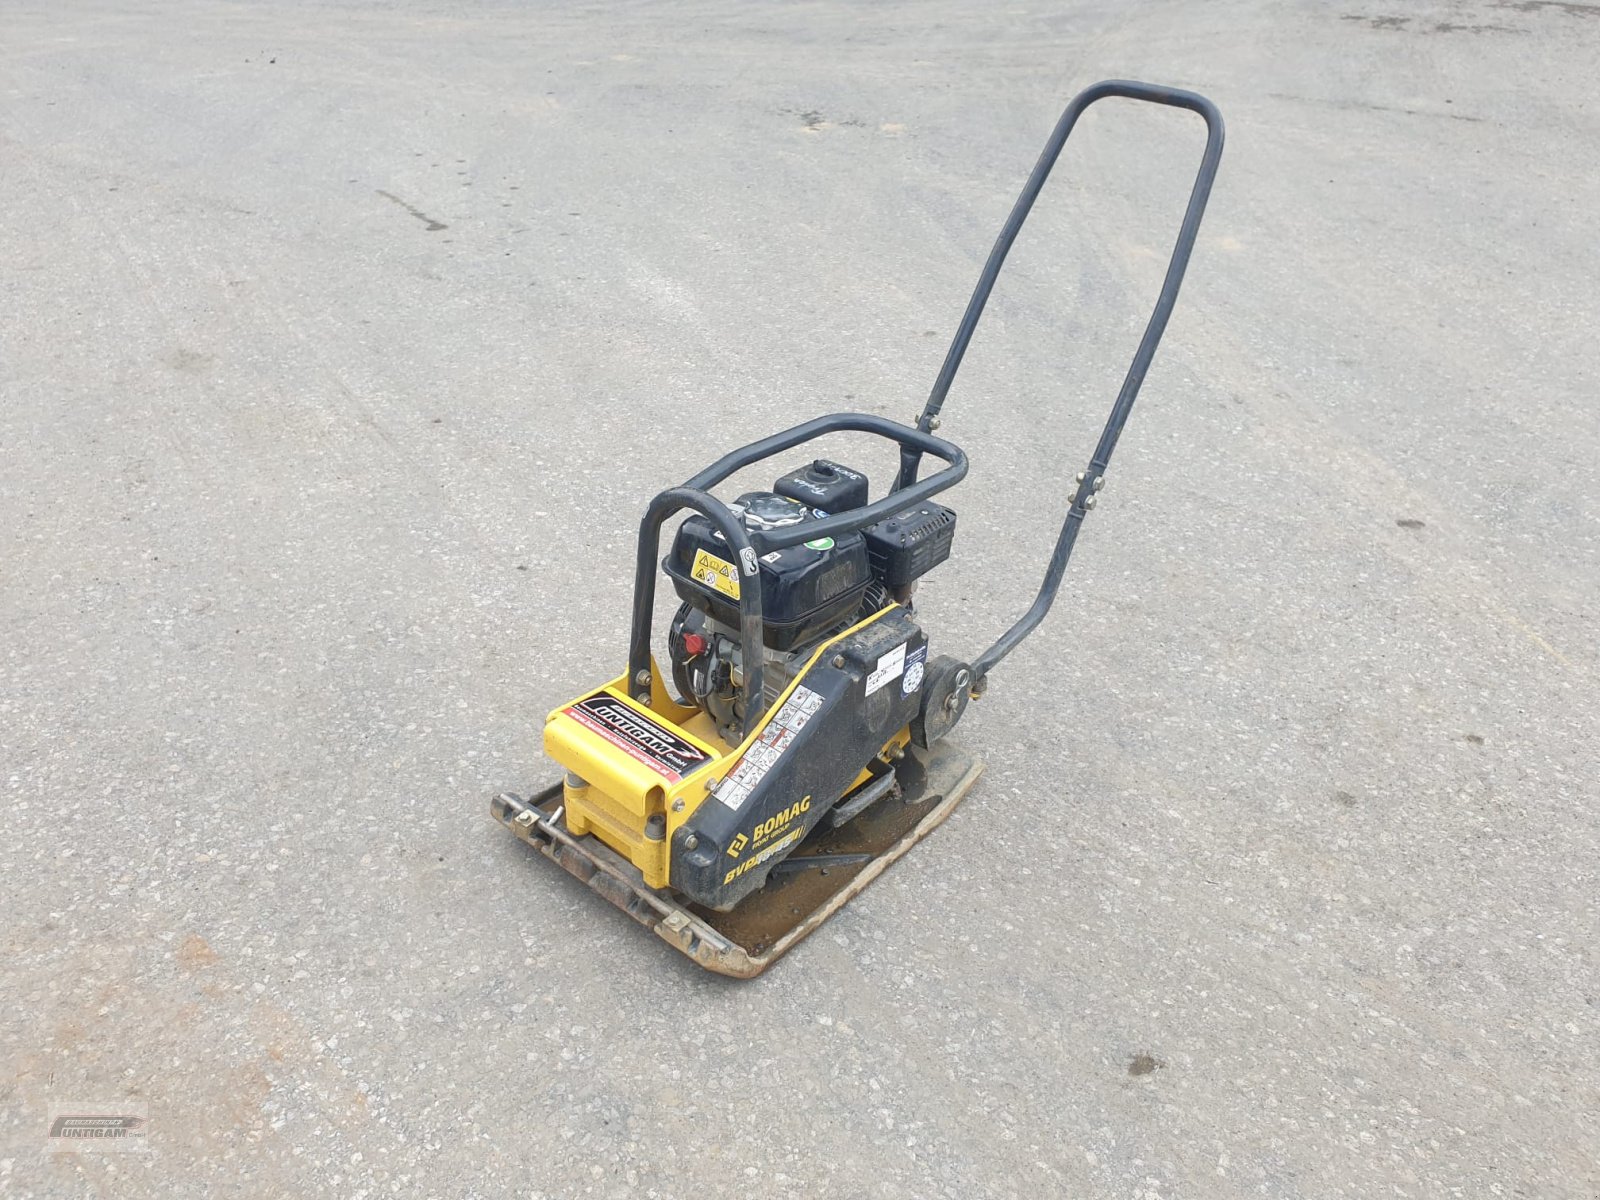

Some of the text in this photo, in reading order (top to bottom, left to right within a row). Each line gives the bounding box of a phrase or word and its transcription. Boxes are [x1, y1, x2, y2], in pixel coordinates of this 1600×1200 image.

[569, 711, 671, 775] www.baumaschinen-puntigam.at
[666, 753, 687, 767] GmbH
[753, 795, 811, 842] BOMAG
